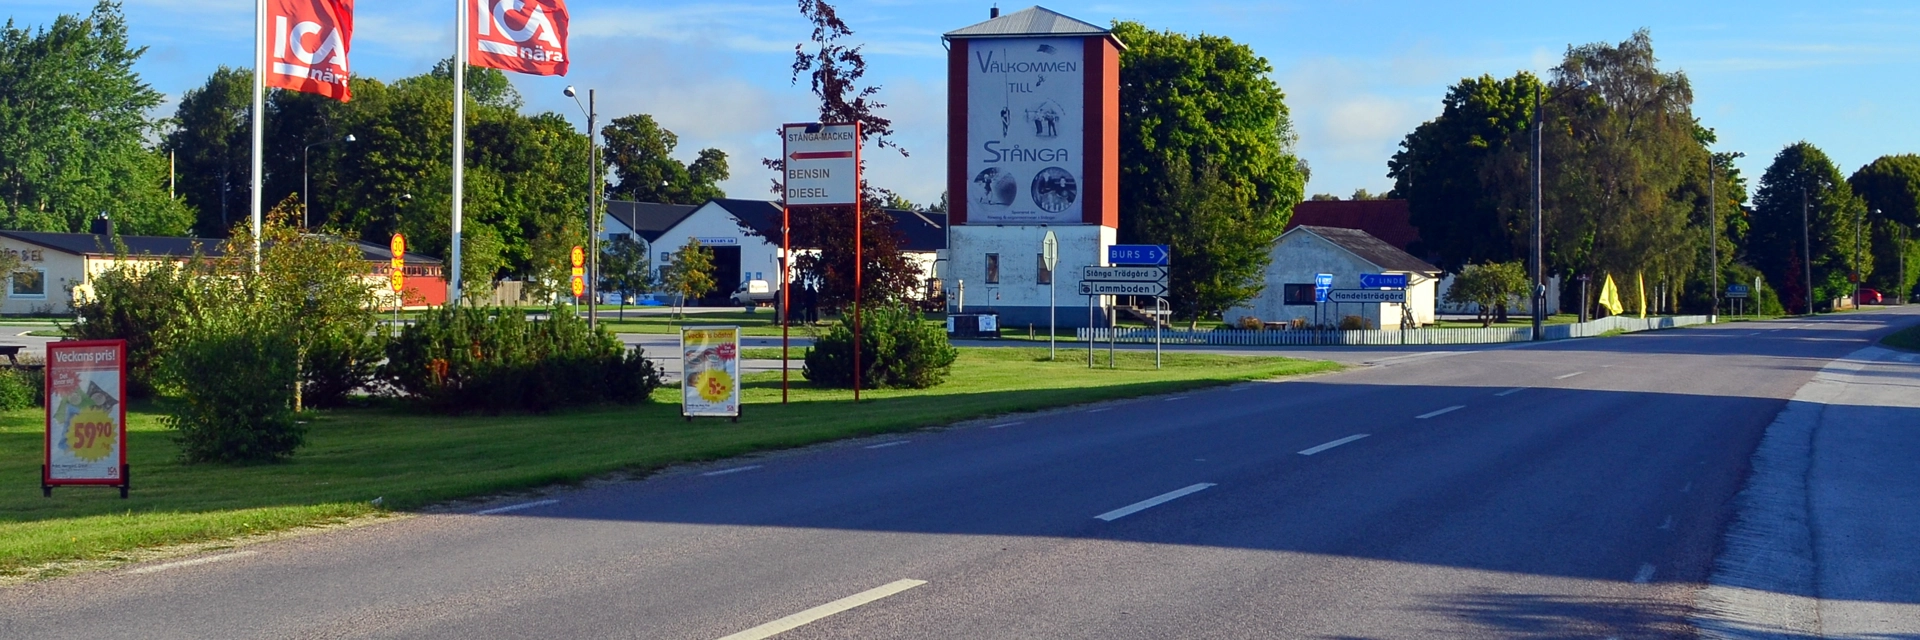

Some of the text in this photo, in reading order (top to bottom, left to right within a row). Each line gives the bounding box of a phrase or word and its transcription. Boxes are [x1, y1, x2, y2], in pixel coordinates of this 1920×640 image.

[477, 0, 562, 49] ICA
[273, 15, 347, 72] ICA
[519, 45, 564, 62] nära
[976, 50, 1076, 73] VÄLKOMMEN
[1008, 82, 1032, 93] TILL
[788, 132, 854, 143] STÅNGA-MACKEN
[983, 140, 1068, 163] STÅNGA
[788, 168, 830, 179] BENSIN
[788, 187, 829, 198] DIESEL
[393, 240, 402, 252] 30
[573, 252, 581, 263] 30
[1111, 250, 1155, 259] BURS 5
[1086, 269, 1158, 279] Stånga Trädgård 3
[393, 275, 402, 286] 50
[574, 281, 582, 291] 50
[1095, 284, 1156, 293] Lammboden 1
[1335, 292, 1404, 300] Handelsträdgård
[55, 349, 116, 364] Veckans pris!
